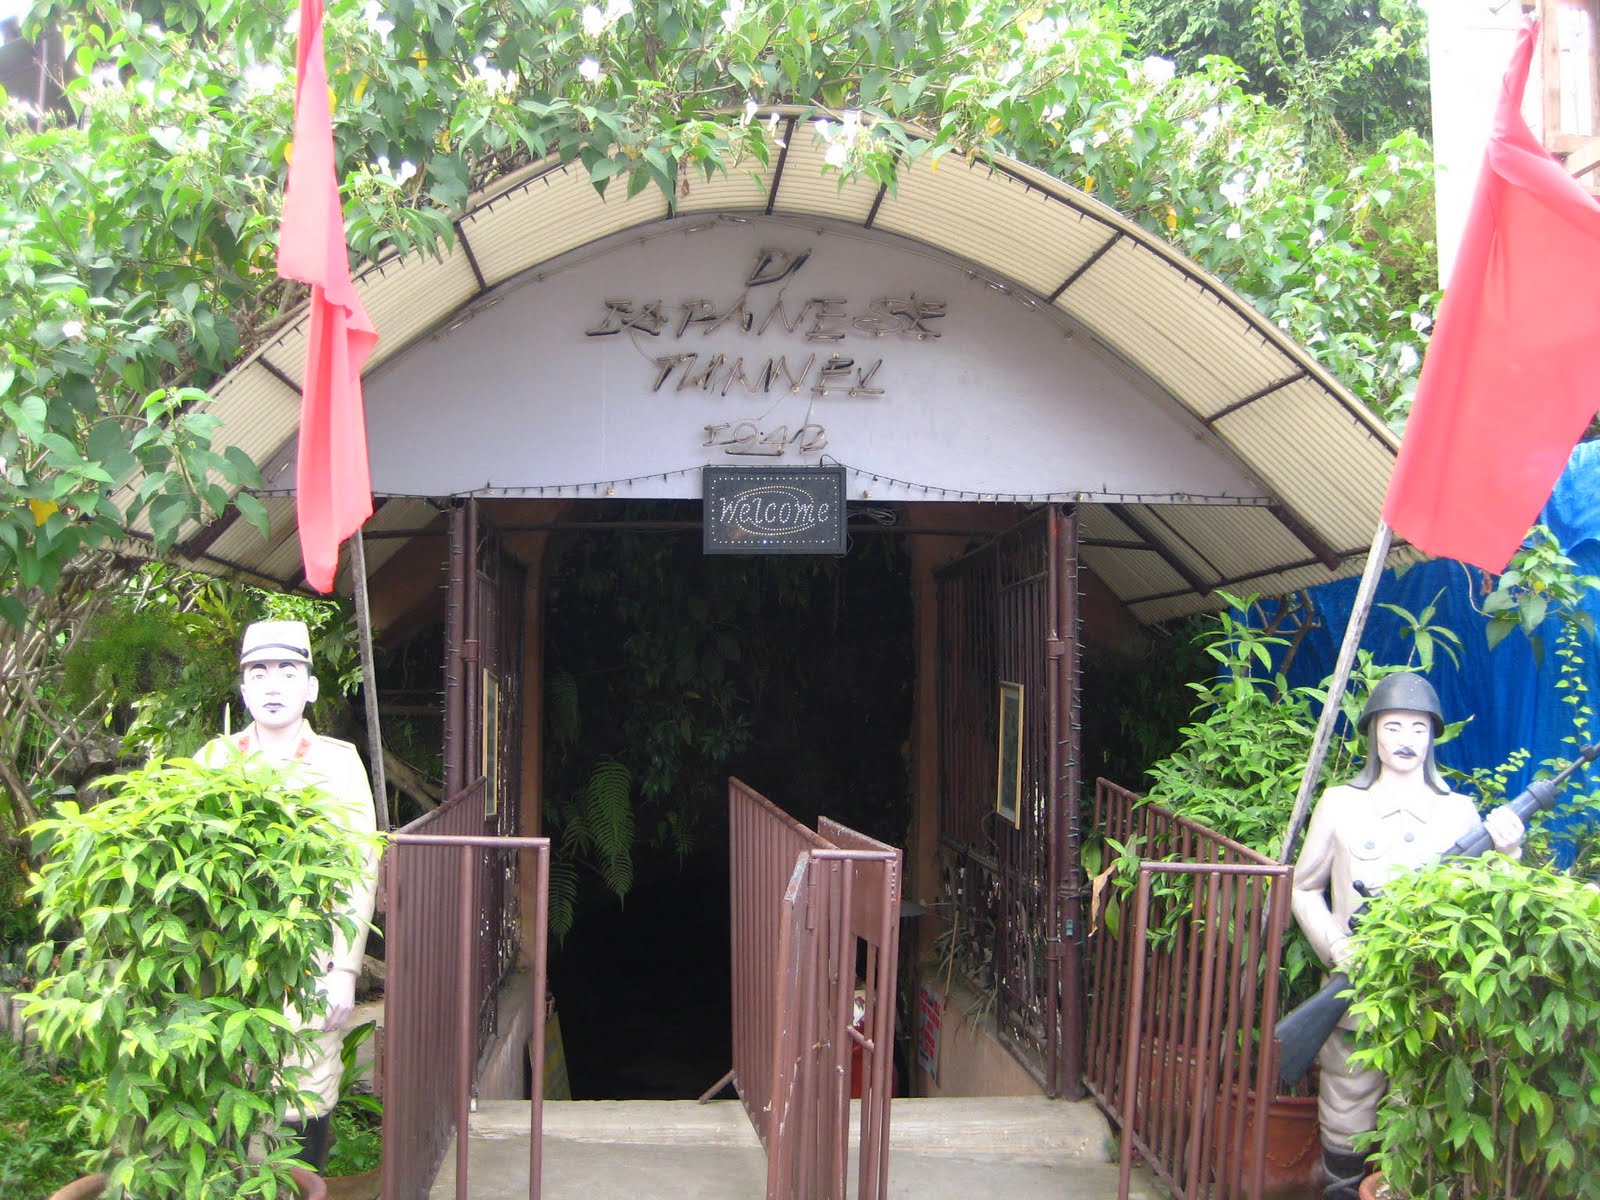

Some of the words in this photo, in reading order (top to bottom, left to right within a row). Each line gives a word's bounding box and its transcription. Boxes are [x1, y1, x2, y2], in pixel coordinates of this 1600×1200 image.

[586, 299, 946, 341] JAPANESE
[653, 352, 886, 397] TUNNEL
[719, 497, 830, 525] Welcome
